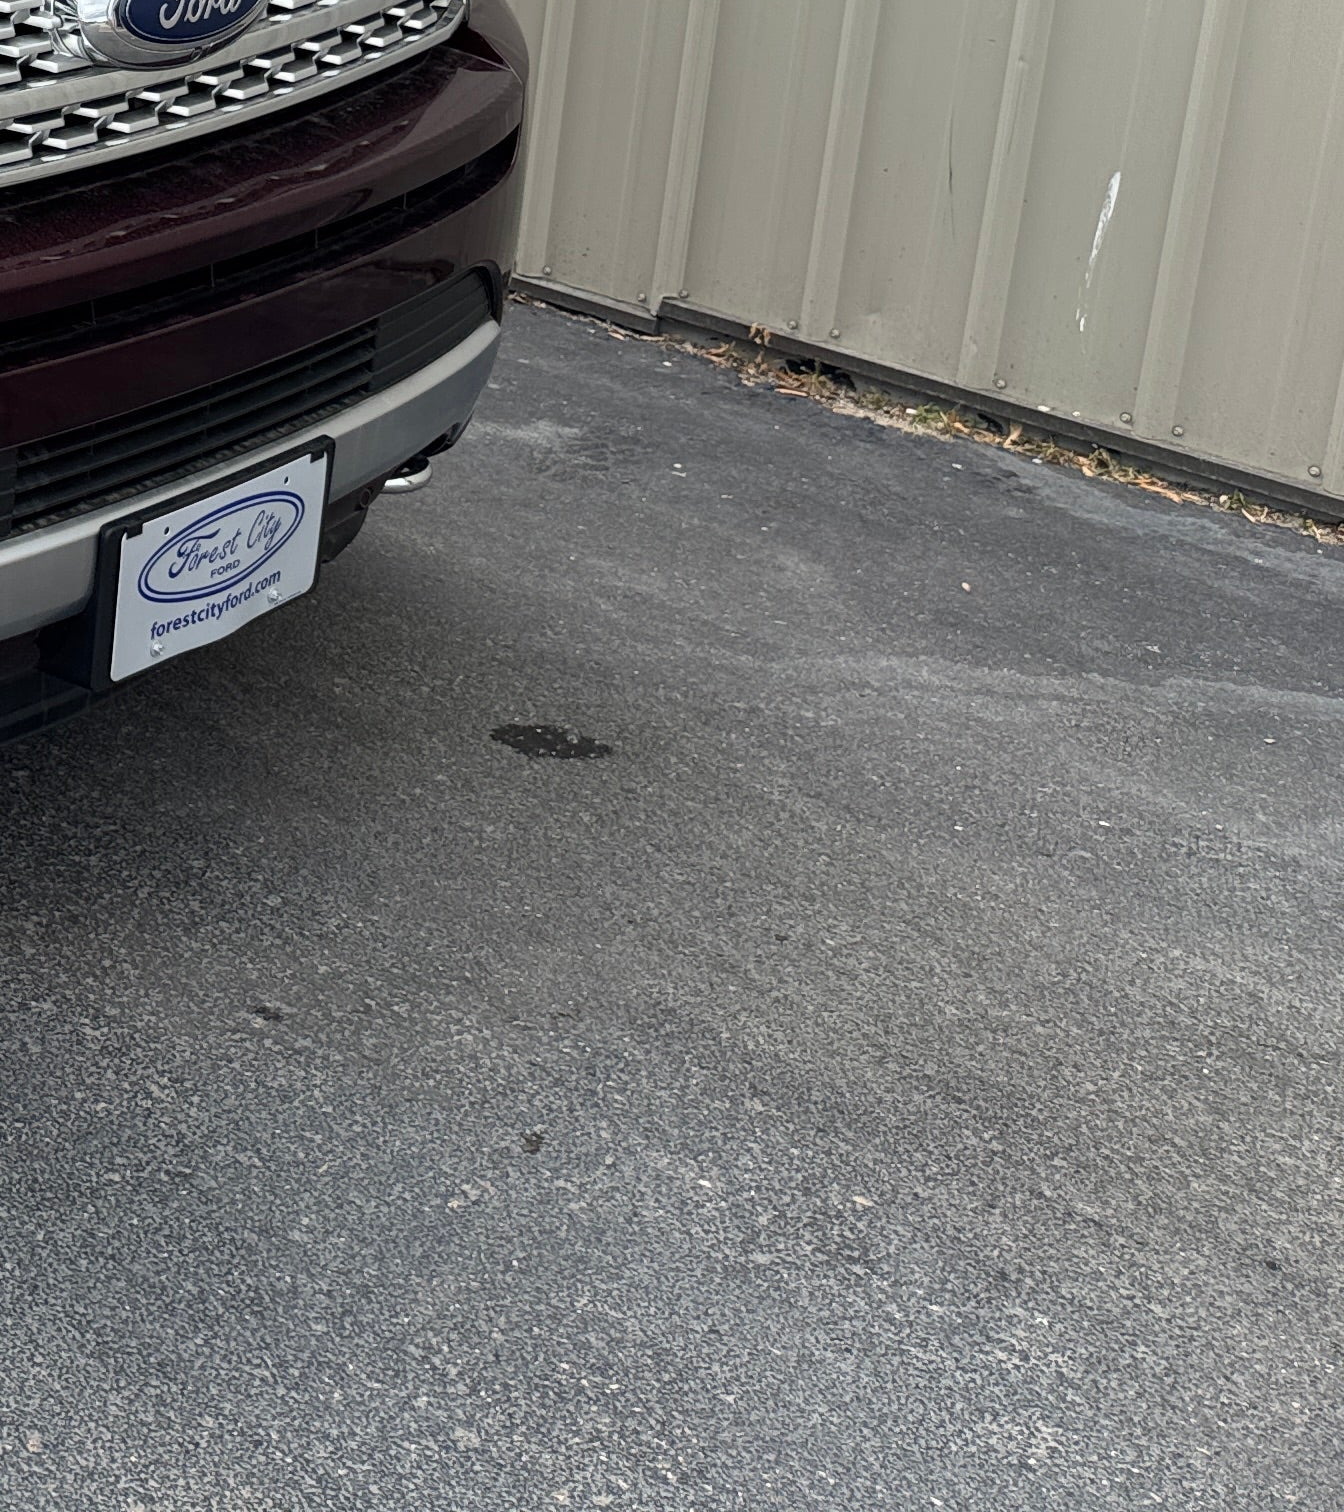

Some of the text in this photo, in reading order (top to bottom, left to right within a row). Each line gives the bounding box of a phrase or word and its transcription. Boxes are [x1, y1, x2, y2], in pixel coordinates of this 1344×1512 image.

[168, 509, 282, 579] Forest City
[210, 559, 241, 578] FORD
[150, 569, 282, 639] forestcityford.com
